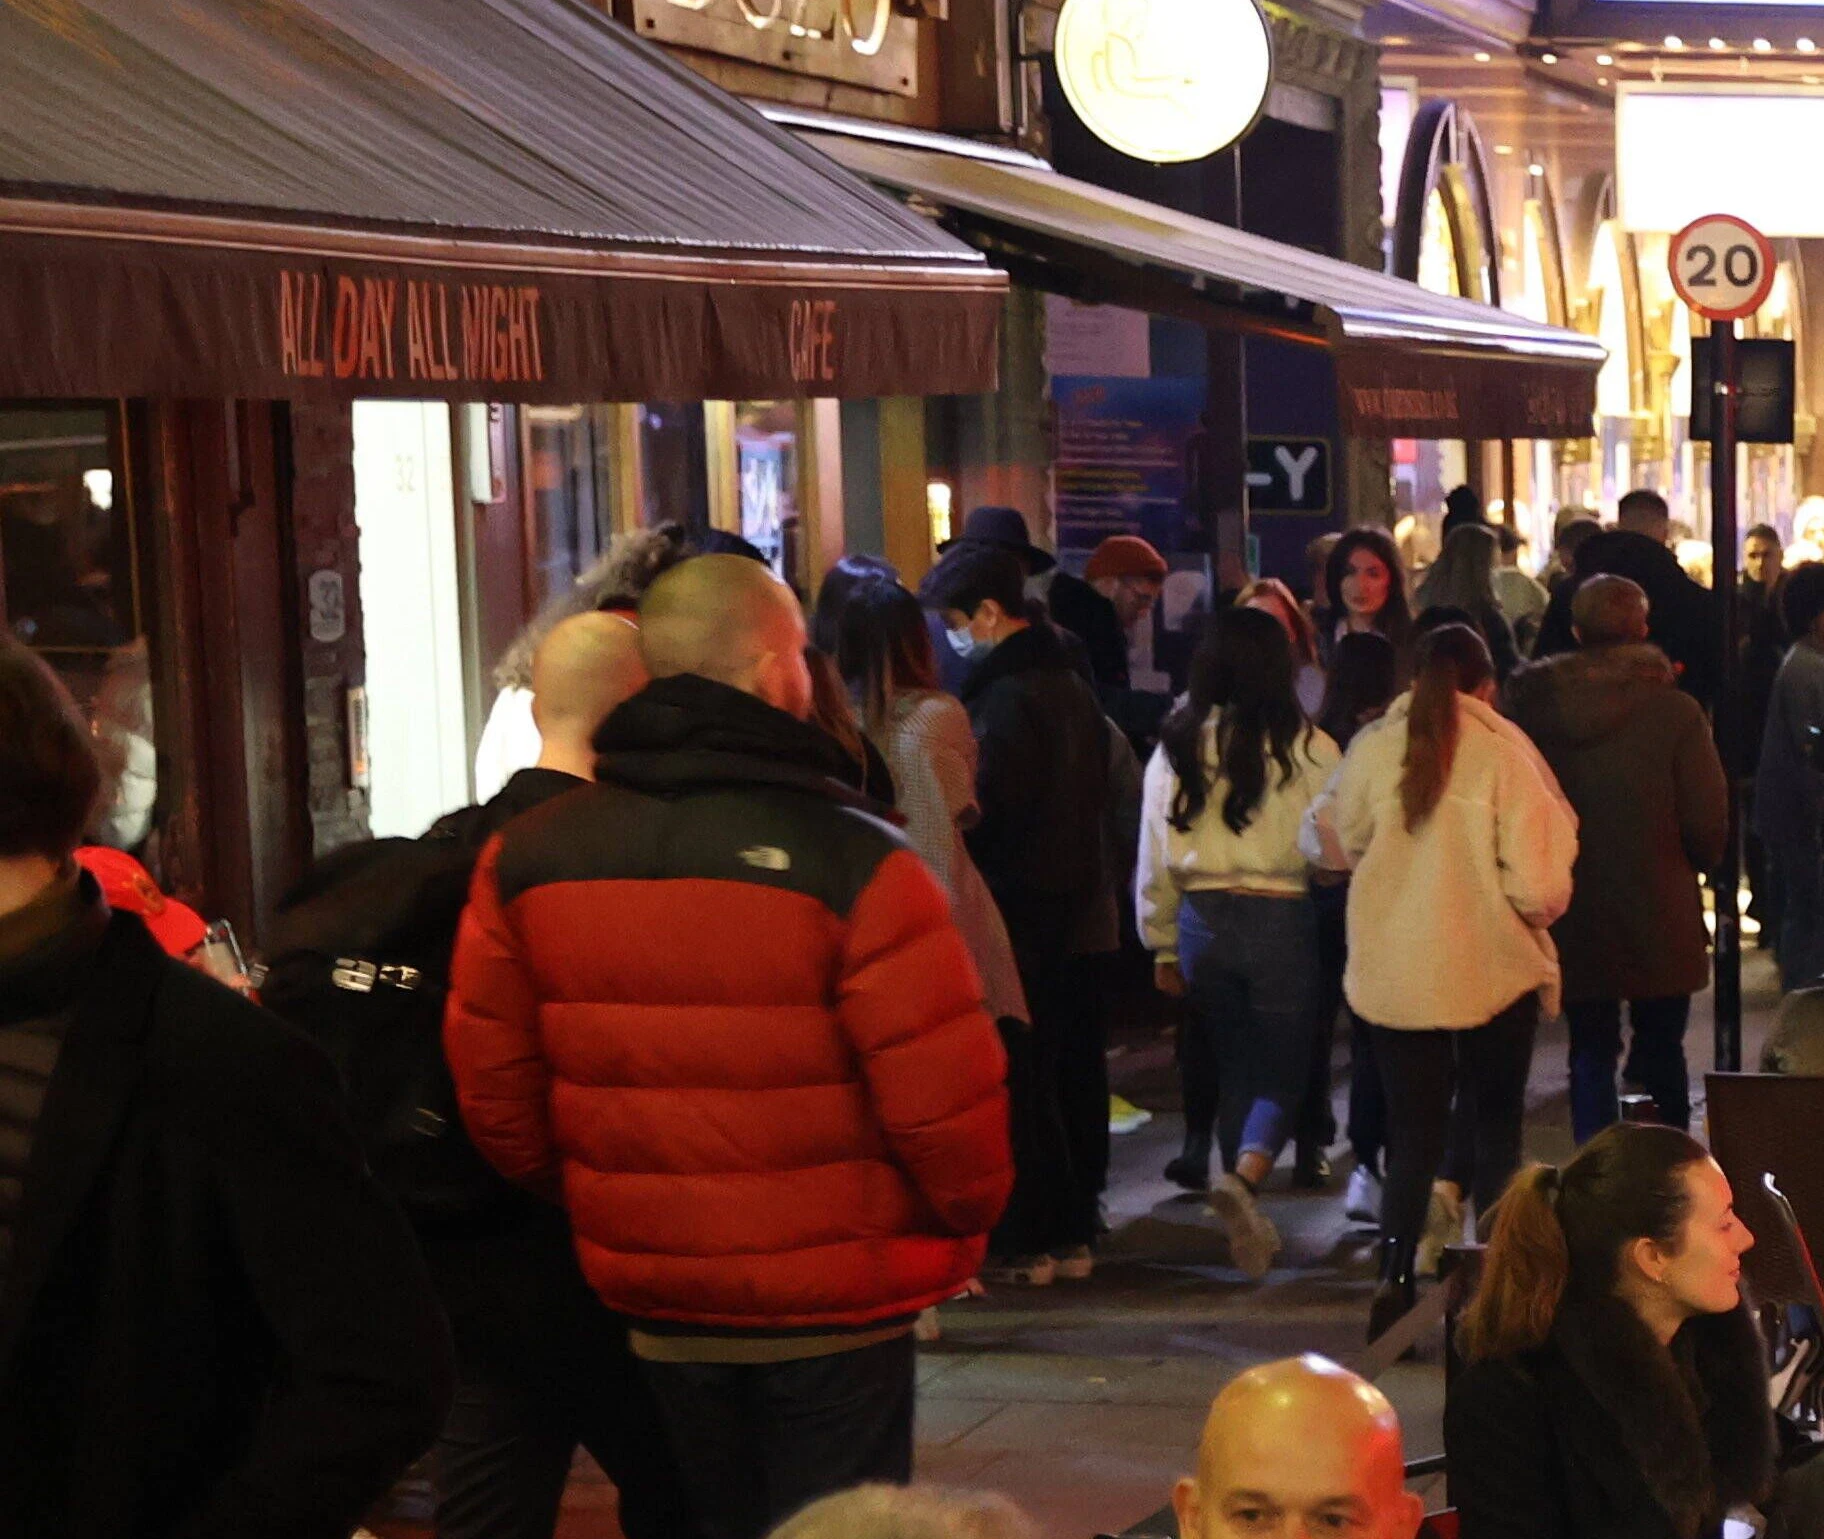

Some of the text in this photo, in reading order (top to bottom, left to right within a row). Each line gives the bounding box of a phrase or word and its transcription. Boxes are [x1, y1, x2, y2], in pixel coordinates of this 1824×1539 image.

[1685, 244, 1758, 288] 20
[280, 269, 544, 383] ALL DAY ALL NIGHT
[788, 299, 838, 383] CAFE
